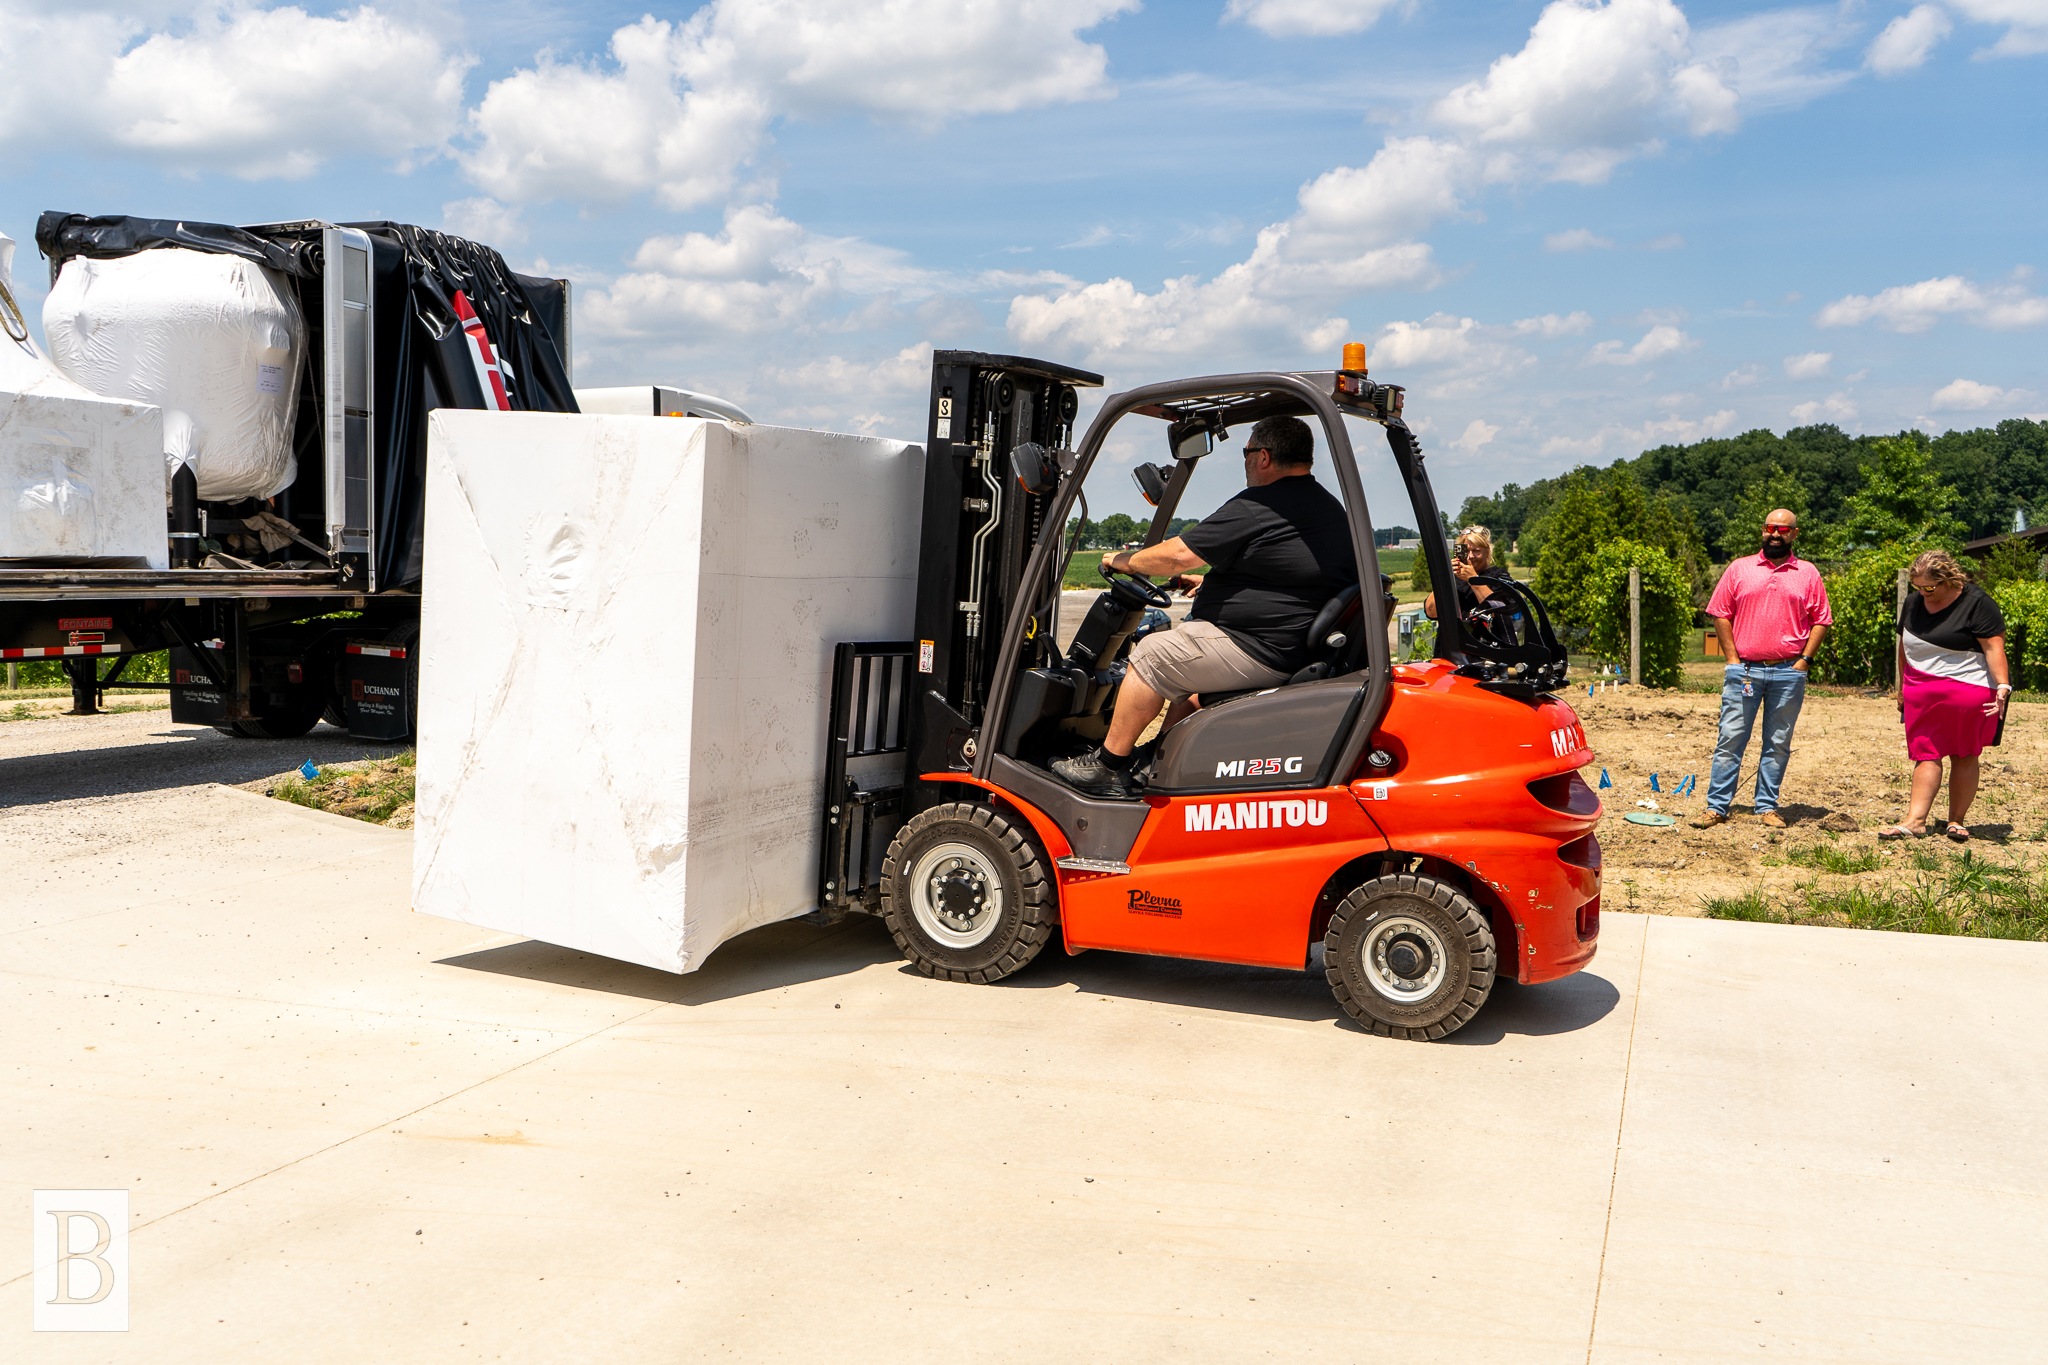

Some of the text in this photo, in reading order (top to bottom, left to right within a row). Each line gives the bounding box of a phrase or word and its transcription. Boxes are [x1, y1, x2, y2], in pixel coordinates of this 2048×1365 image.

[63, 619, 109, 628] FONTAINE
[354, 682, 400, 697] BUCHANAN
[1185, 799, 1328, 832] MANITOU
[1127, 889, 1182, 908] Plevna
[1405, 902, 1455, 941] ADVANCE
